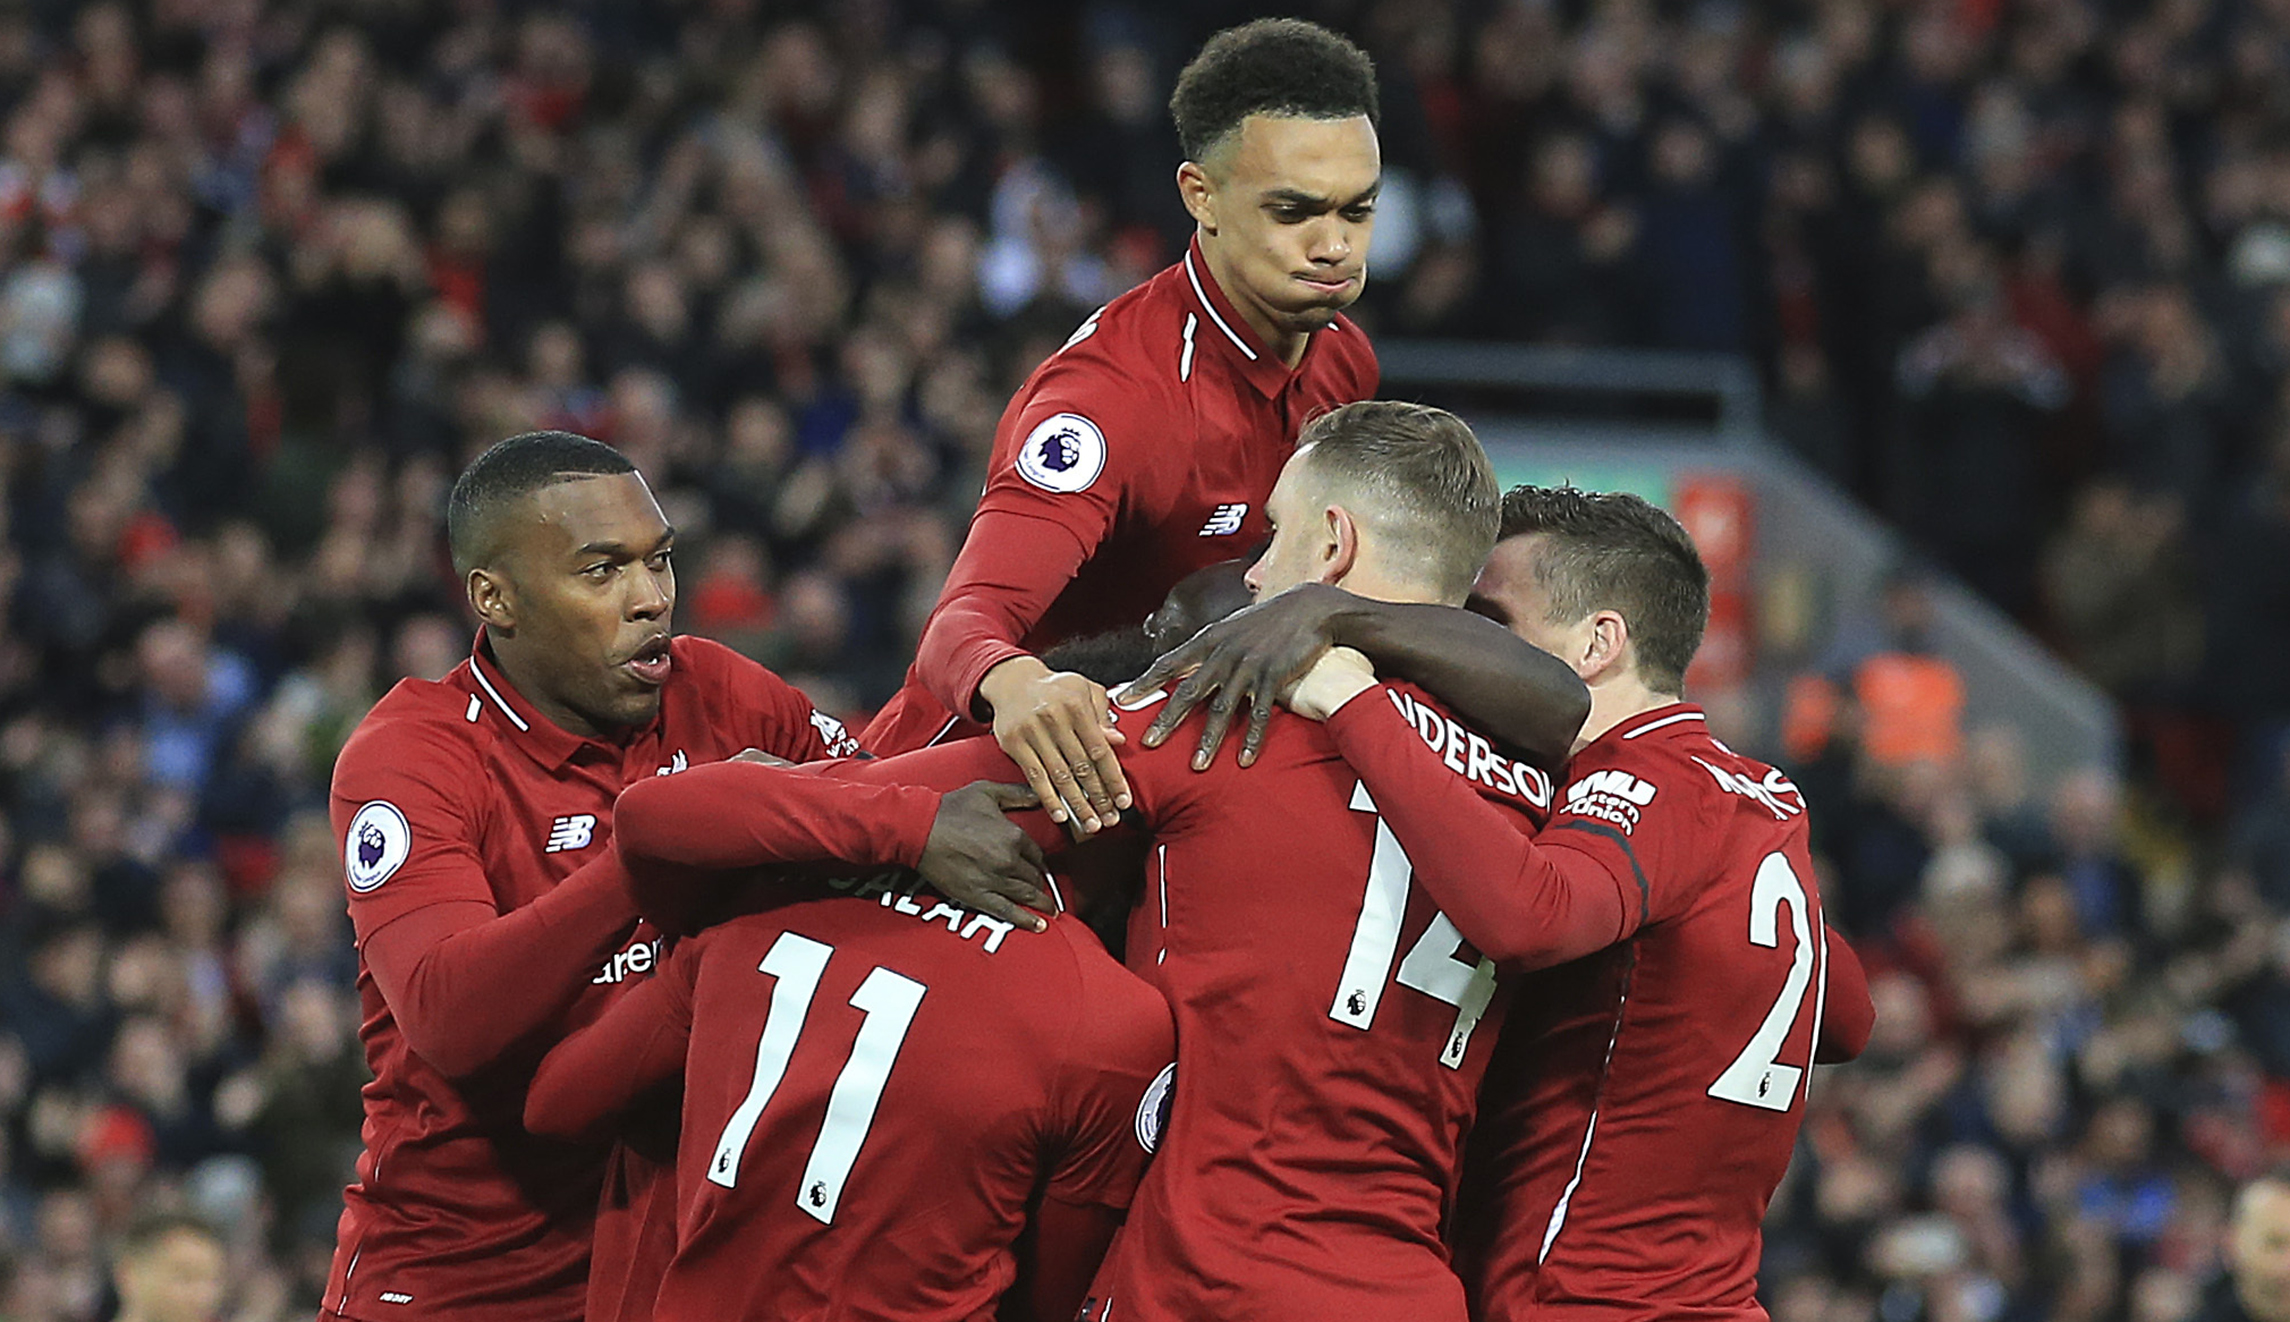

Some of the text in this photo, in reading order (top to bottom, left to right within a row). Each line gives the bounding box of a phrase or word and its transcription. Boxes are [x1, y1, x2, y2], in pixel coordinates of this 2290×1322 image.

[1331, 779, 1497, 1069] 14
[1707, 851, 1829, 1112] 2
[707, 932, 927, 1224] 11
